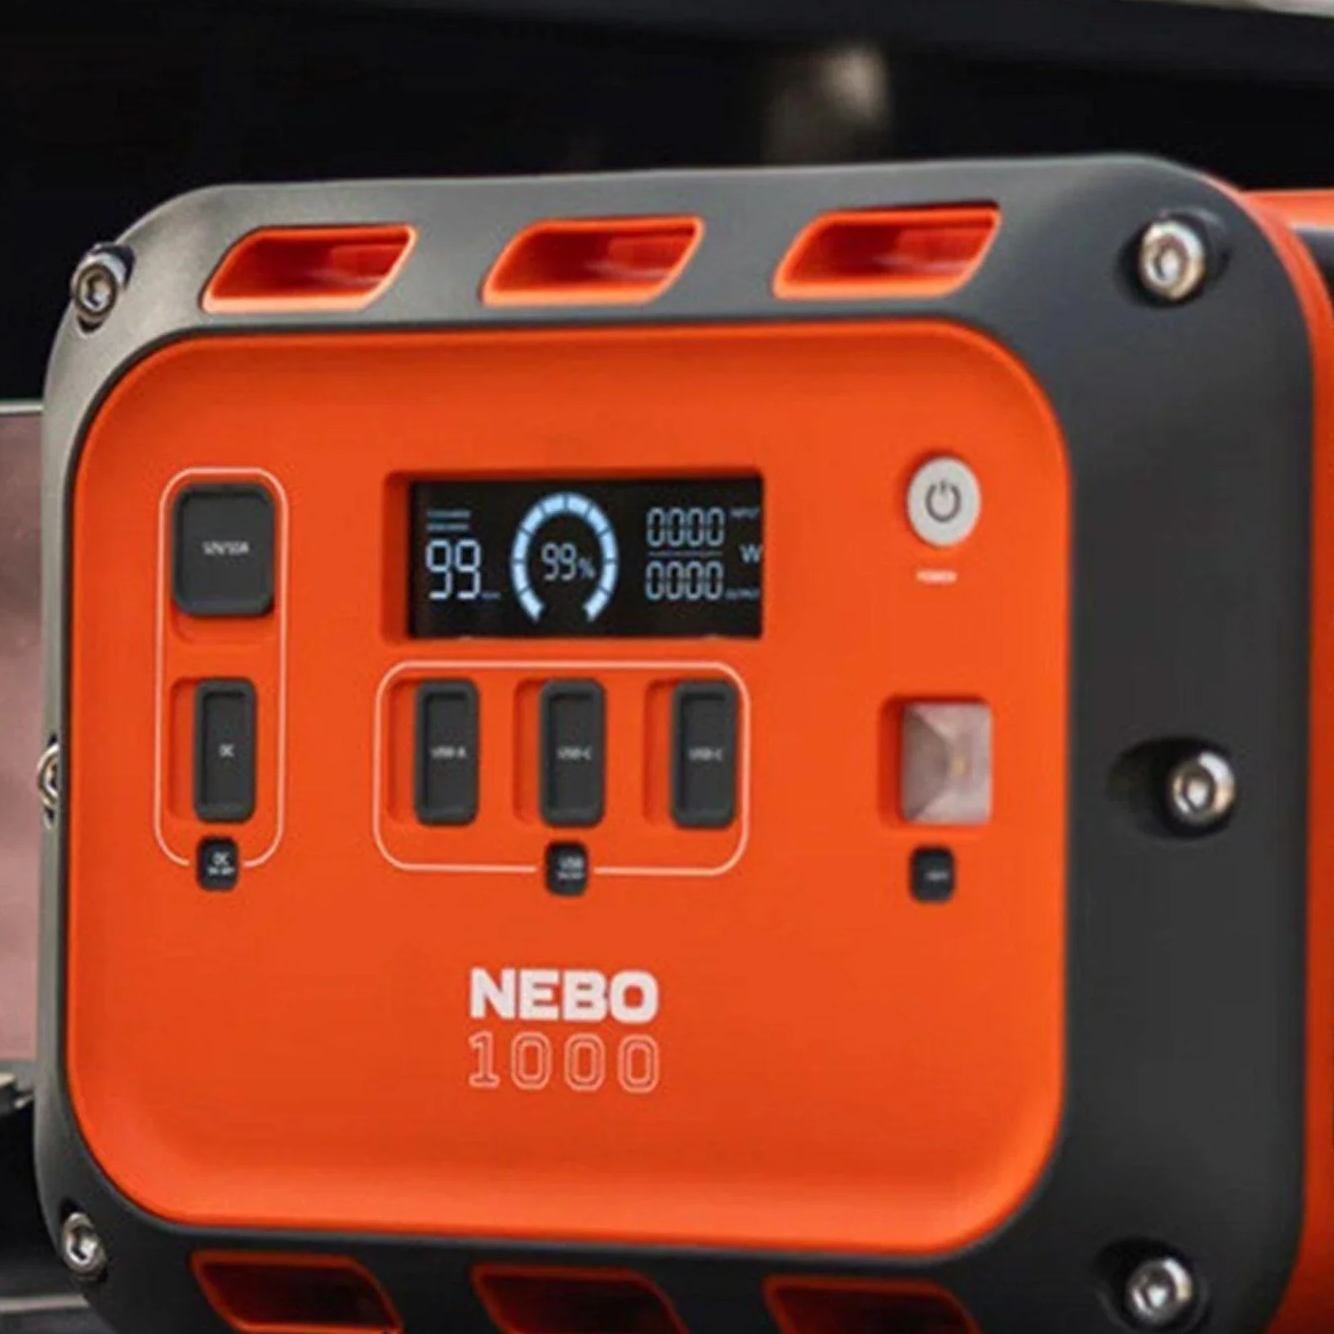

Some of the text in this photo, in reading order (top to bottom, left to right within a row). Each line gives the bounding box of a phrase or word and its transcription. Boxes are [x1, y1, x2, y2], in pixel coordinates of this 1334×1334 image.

[647, 507, 725, 547] 0000
[425, 539, 482, 600] 99
[739, 544, 763, 564] W
[645, 561, 724, 600] 0000
[470, 967, 660, 1025] NEBO
[468, 1030, 660, 1093] 1000
